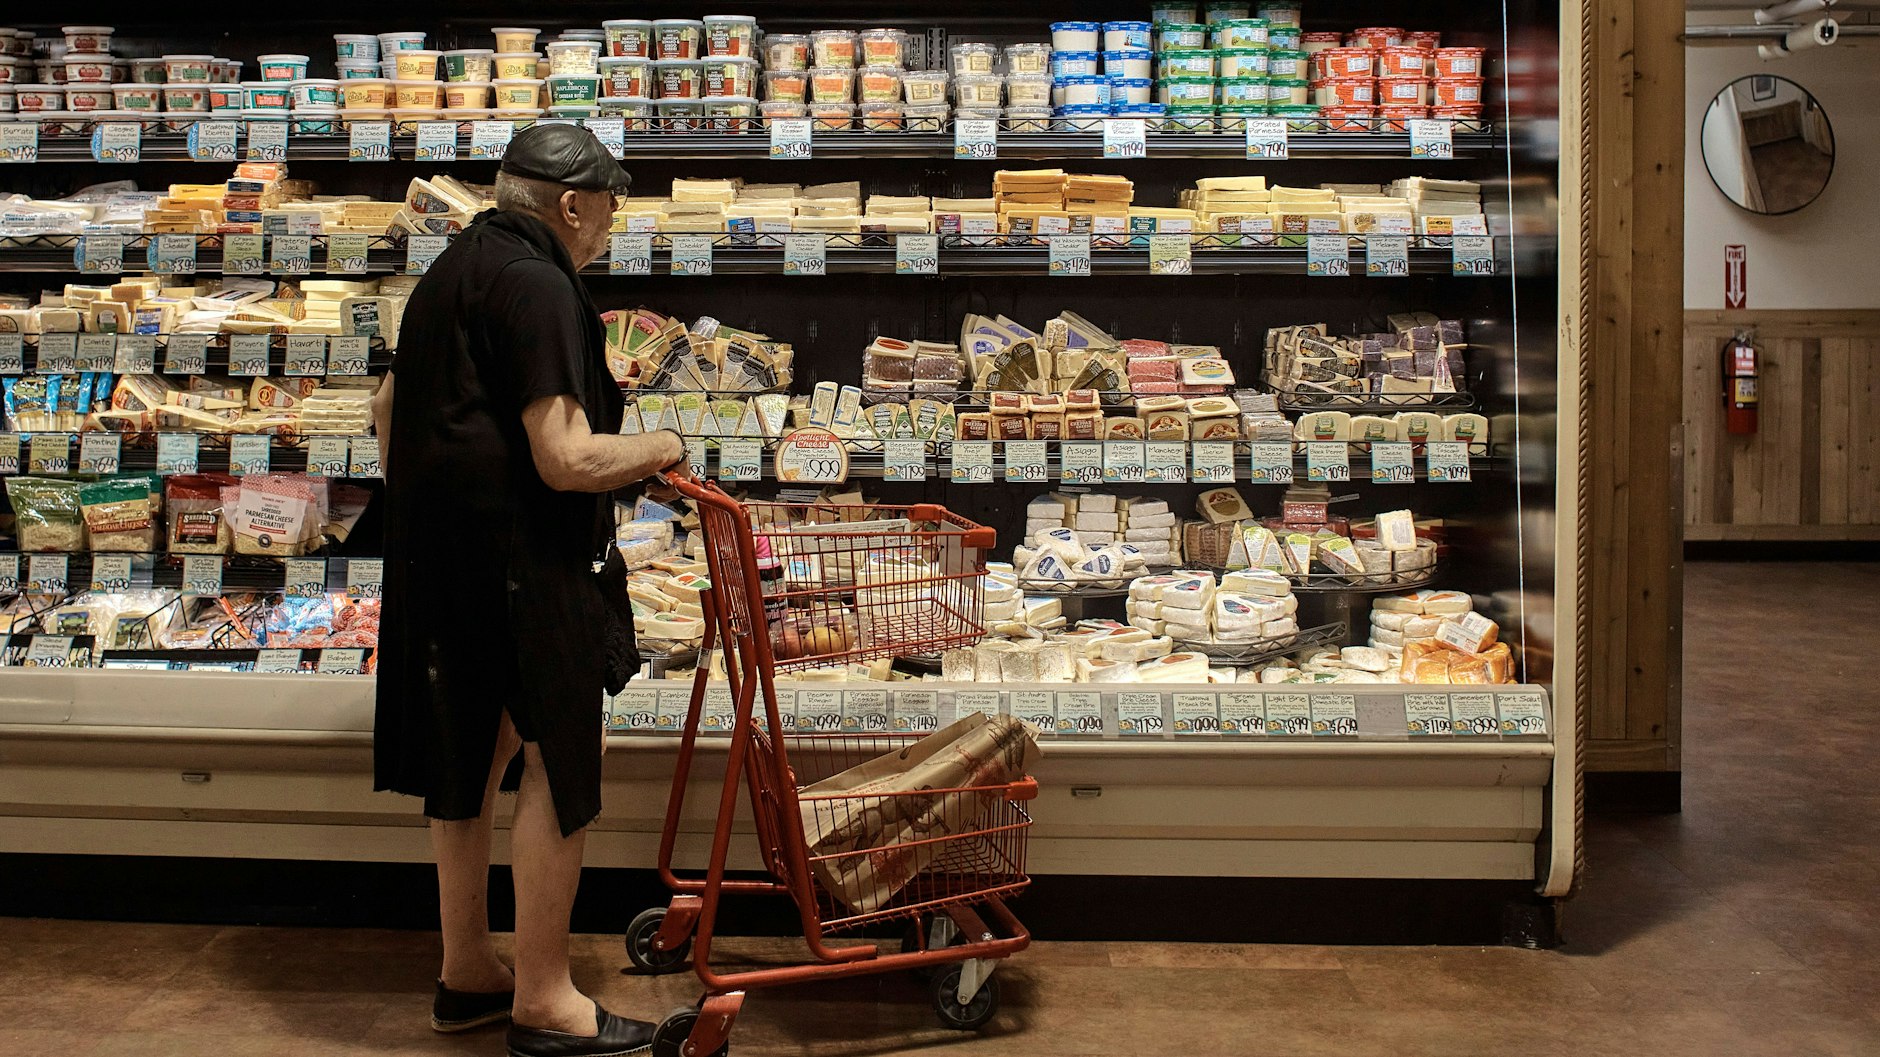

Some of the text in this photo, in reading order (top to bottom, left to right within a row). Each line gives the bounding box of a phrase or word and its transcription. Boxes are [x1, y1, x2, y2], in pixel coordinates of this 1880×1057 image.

[4, 127, 34, 135] Burrata
[1728, 251, 1742, 259] FIRE
[290, 339, 322, 348] Havarti
[1066, 446, 1097, 455] Asiago
[183, 514, 216, 523] SHREDDED
[246, 510, 294, 523] PARMESAN CHEESE
[251, 518, 285, 529] ALTERNATIVE
